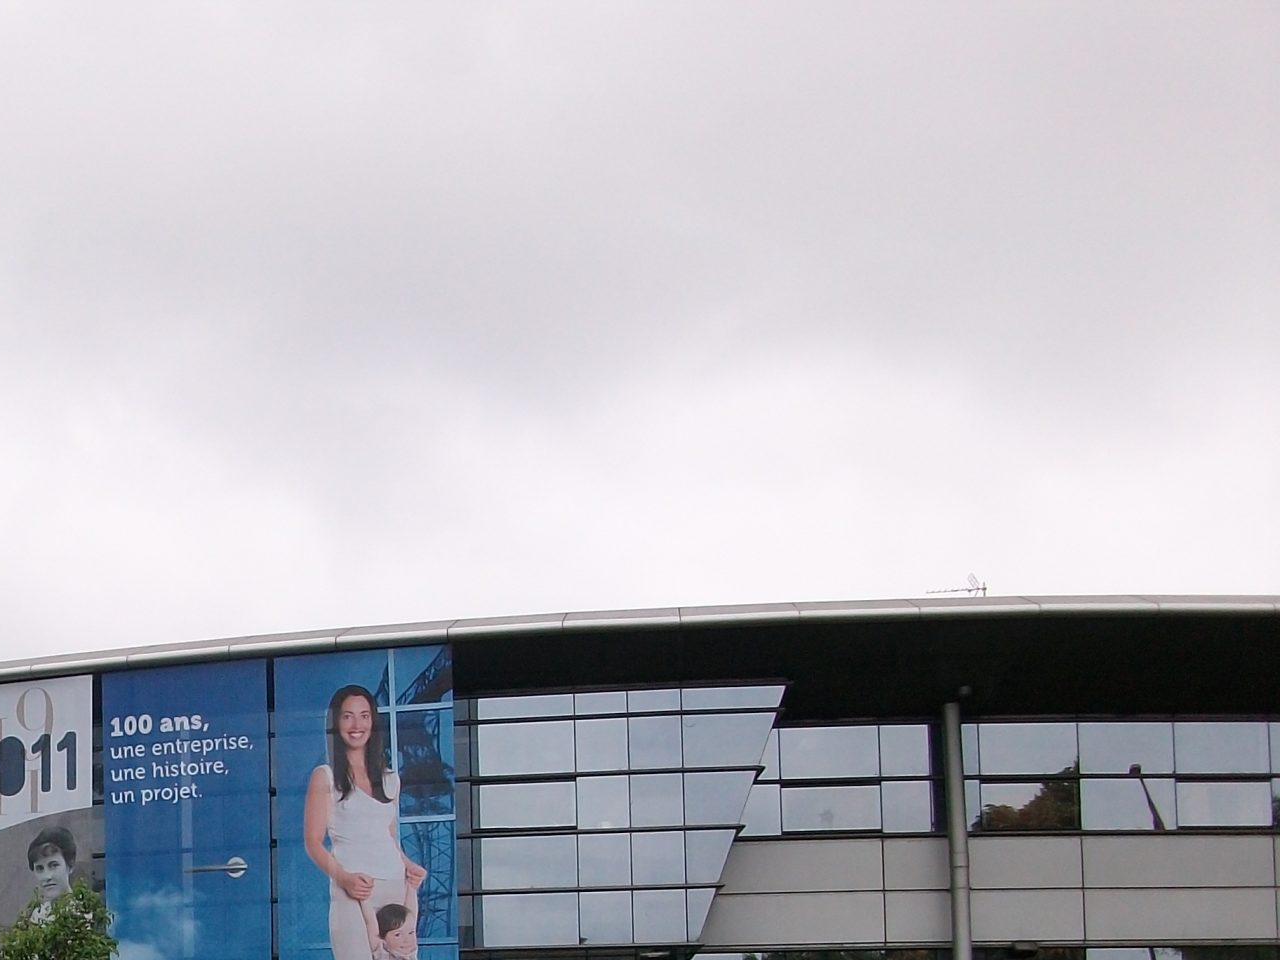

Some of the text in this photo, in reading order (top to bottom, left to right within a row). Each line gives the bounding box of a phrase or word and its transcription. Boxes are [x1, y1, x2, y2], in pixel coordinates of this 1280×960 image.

[110, 714, 210, 738] 100 ans,
[110, 734, 254, 760] une entreprise,
[110, 758, 230, 782] une histoire,
[111, 783, 203, 806] un projet.
